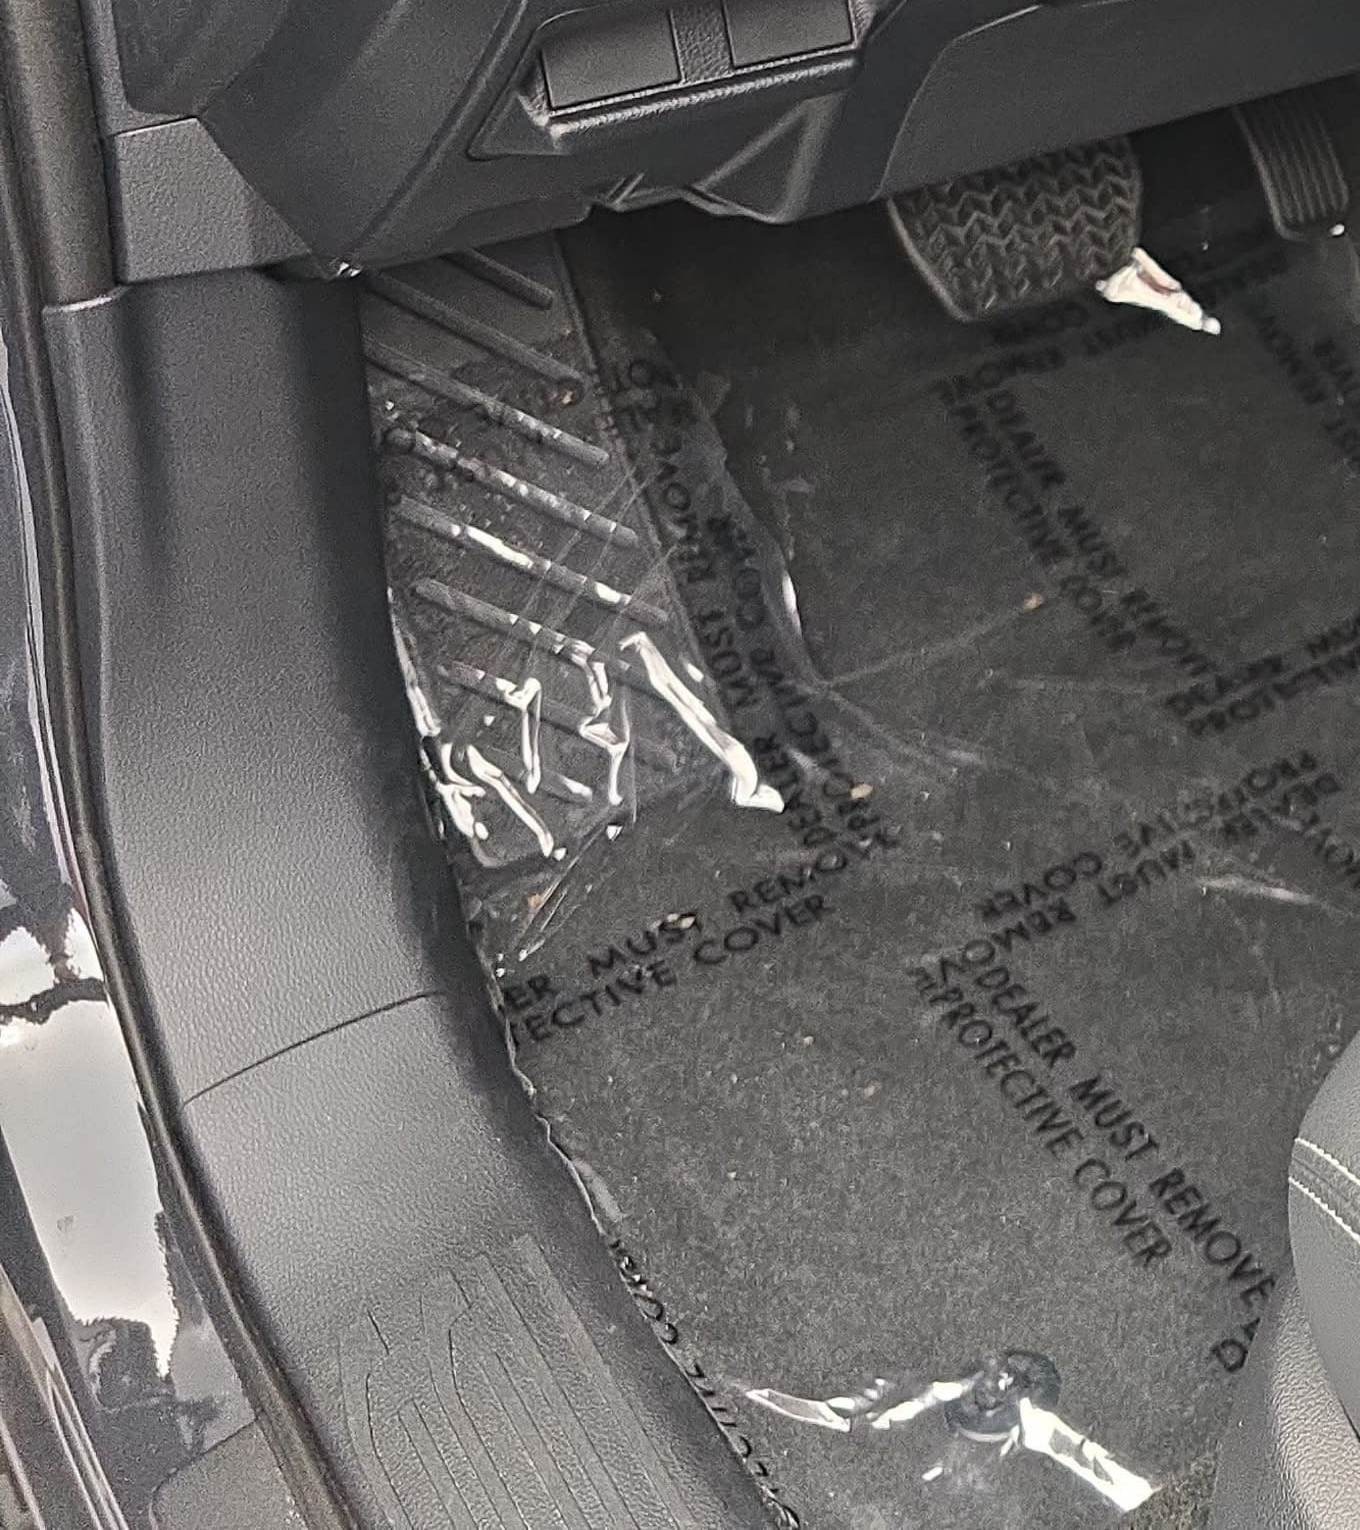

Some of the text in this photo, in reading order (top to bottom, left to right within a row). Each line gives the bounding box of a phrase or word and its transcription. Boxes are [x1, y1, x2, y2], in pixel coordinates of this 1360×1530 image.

[1057, 505, 1130, 578] MUST
[972, 849, 1104, 925] COVER
[690, 894, 832, 968] COVER
[927, 983, 1175, 1270] PROTECTIVE COVER
[973, 964, 1078, 1070] DEALER
[1067, 1074, 1162, 1164] MUST
[1147, 1167, 1279, 1308] REMOVE
